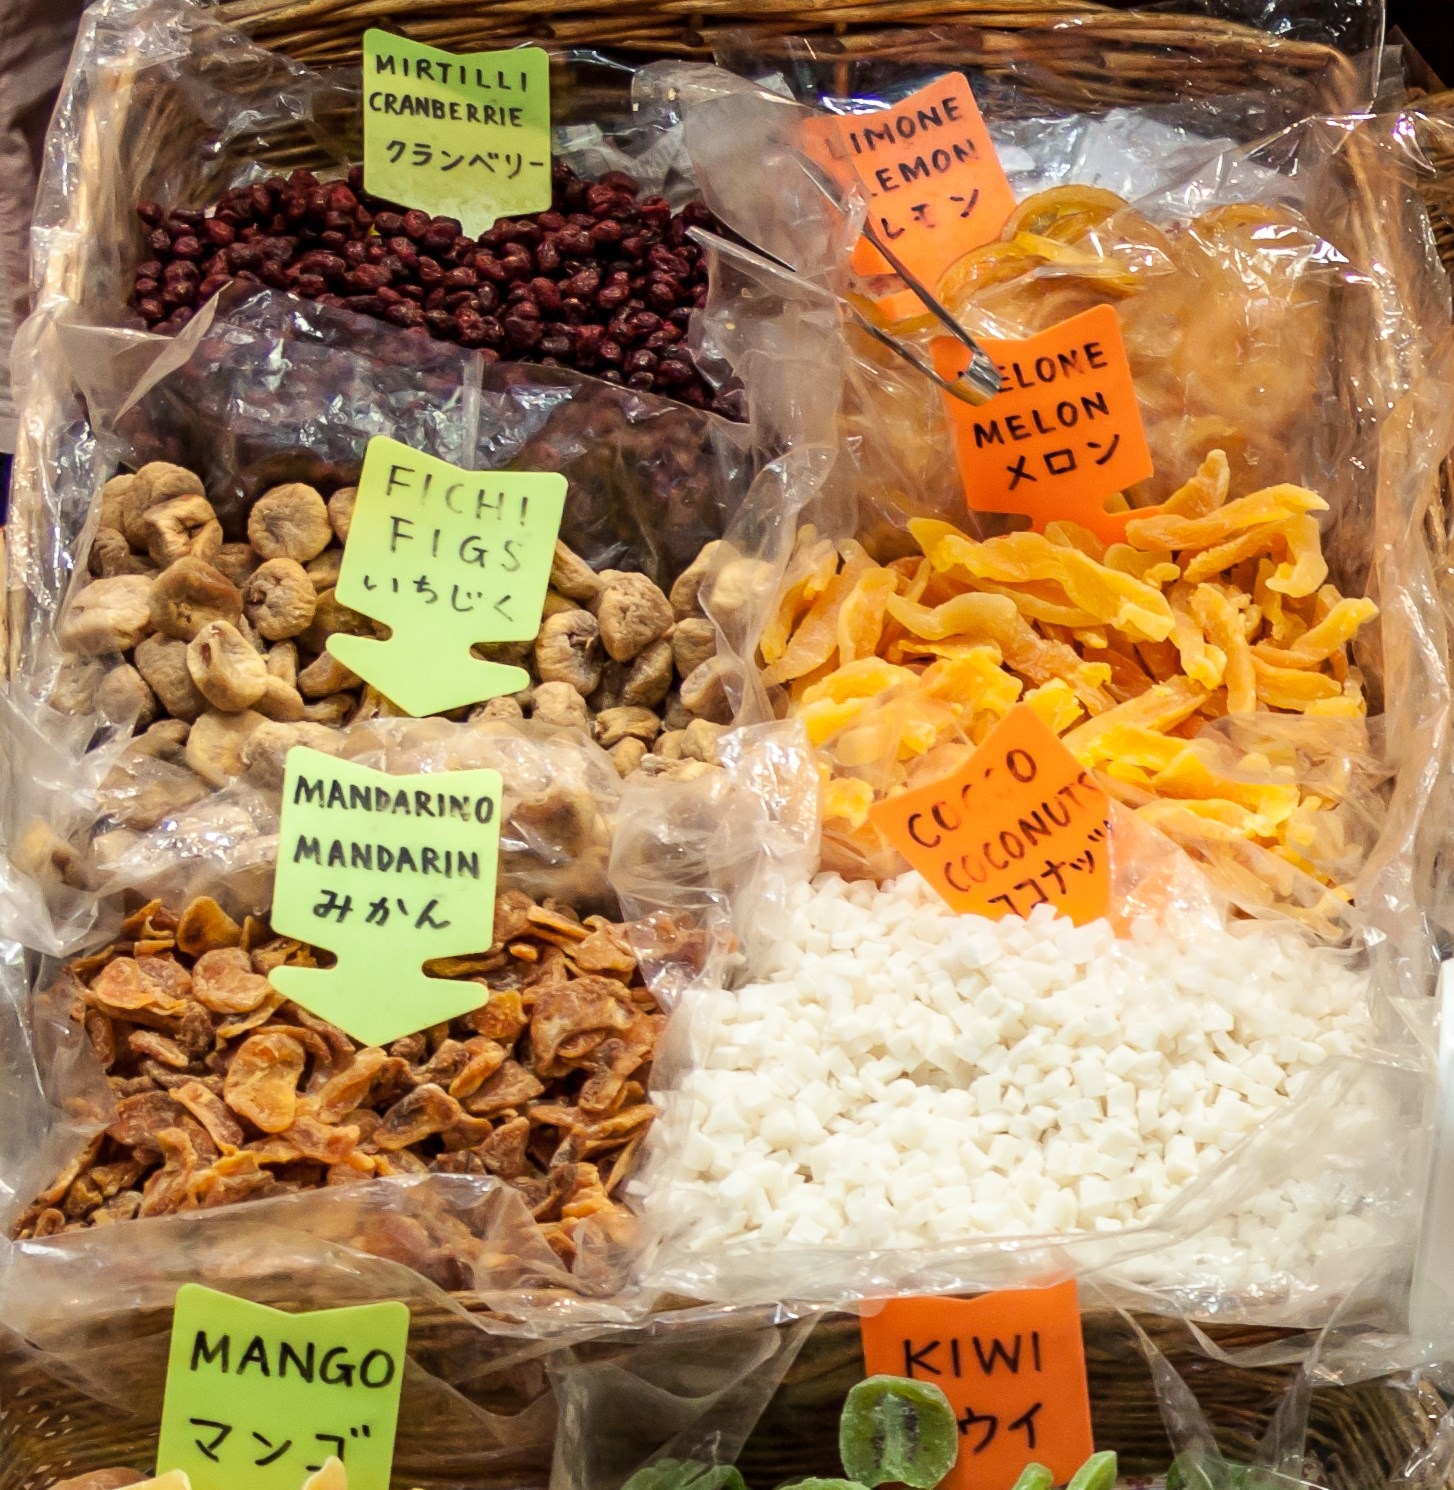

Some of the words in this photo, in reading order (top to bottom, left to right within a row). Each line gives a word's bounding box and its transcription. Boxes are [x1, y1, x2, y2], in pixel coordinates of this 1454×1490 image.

[376, 54, 527, 92] MIRTILLI
[369, 92, 523, 127] CRANBERRIE
[386, 140, 544, 179] クランベリー
[871, 138, 978, 197] EMON
[957, 342, 1108, 393] ELONE
[973, 392, 1109, 448] MELON
[1006, 434, 1121, 491] メロン
[386, 465, 529, 526] FICHI
[390, 515, 523, 572] FIGS
[363, 575, 514, 623] いちじく
[293, 775, 494, 825] MANDARINO
[292, 834, 480, 880] MANDARIN
[312, 889, 451, 929] みかん
[189, 1330, 396, 1388] MANGO
[904, 1331, 1042, 1379] KIWI
